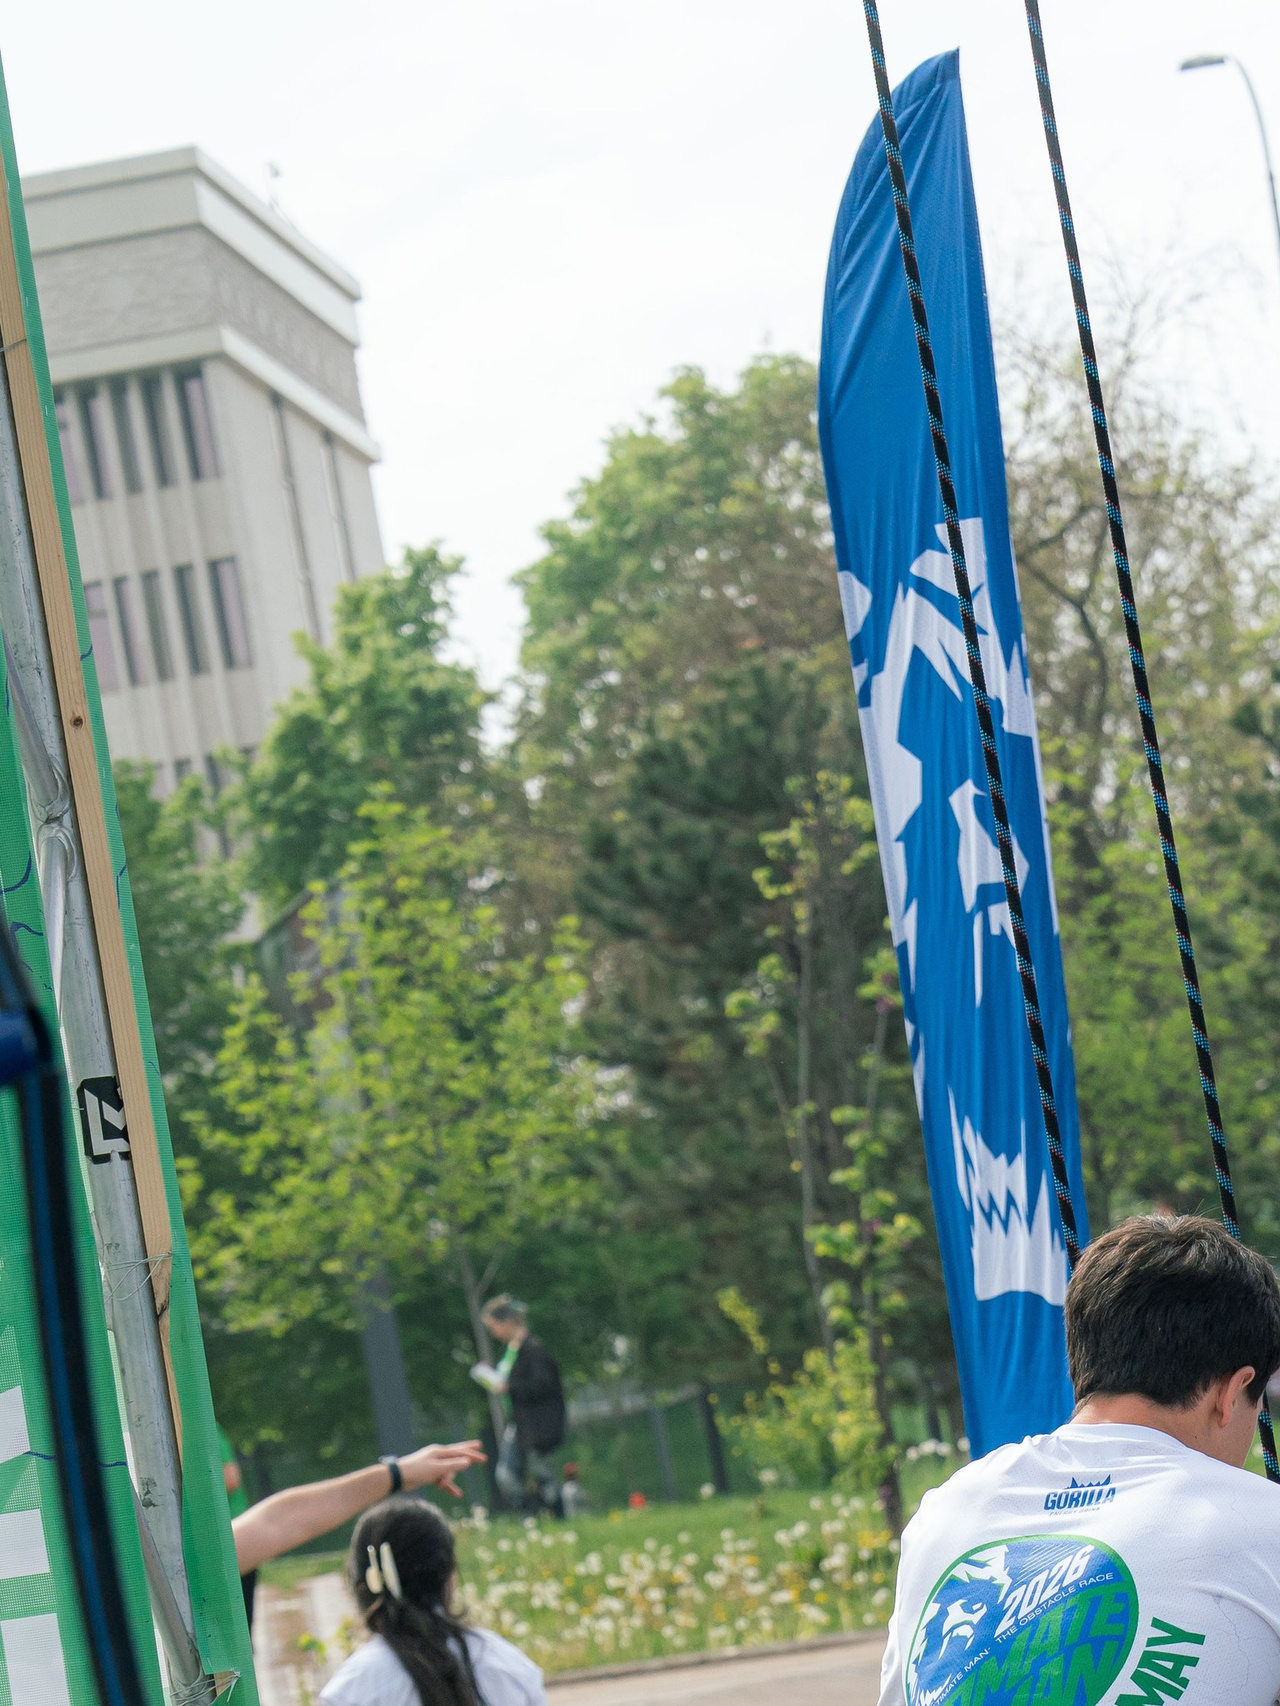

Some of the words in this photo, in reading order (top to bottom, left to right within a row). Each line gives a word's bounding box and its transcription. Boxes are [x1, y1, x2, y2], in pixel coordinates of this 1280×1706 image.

[1044, 1487, 1116, 1511] GORILLA
[994, 1545, 1095, 1638] 2026
[995, 1624, 1018, 1644] THE
[1020, 1585, 1077, 1626] OBSTACLE
[1079, 1572, 1114, 1588] RACE
